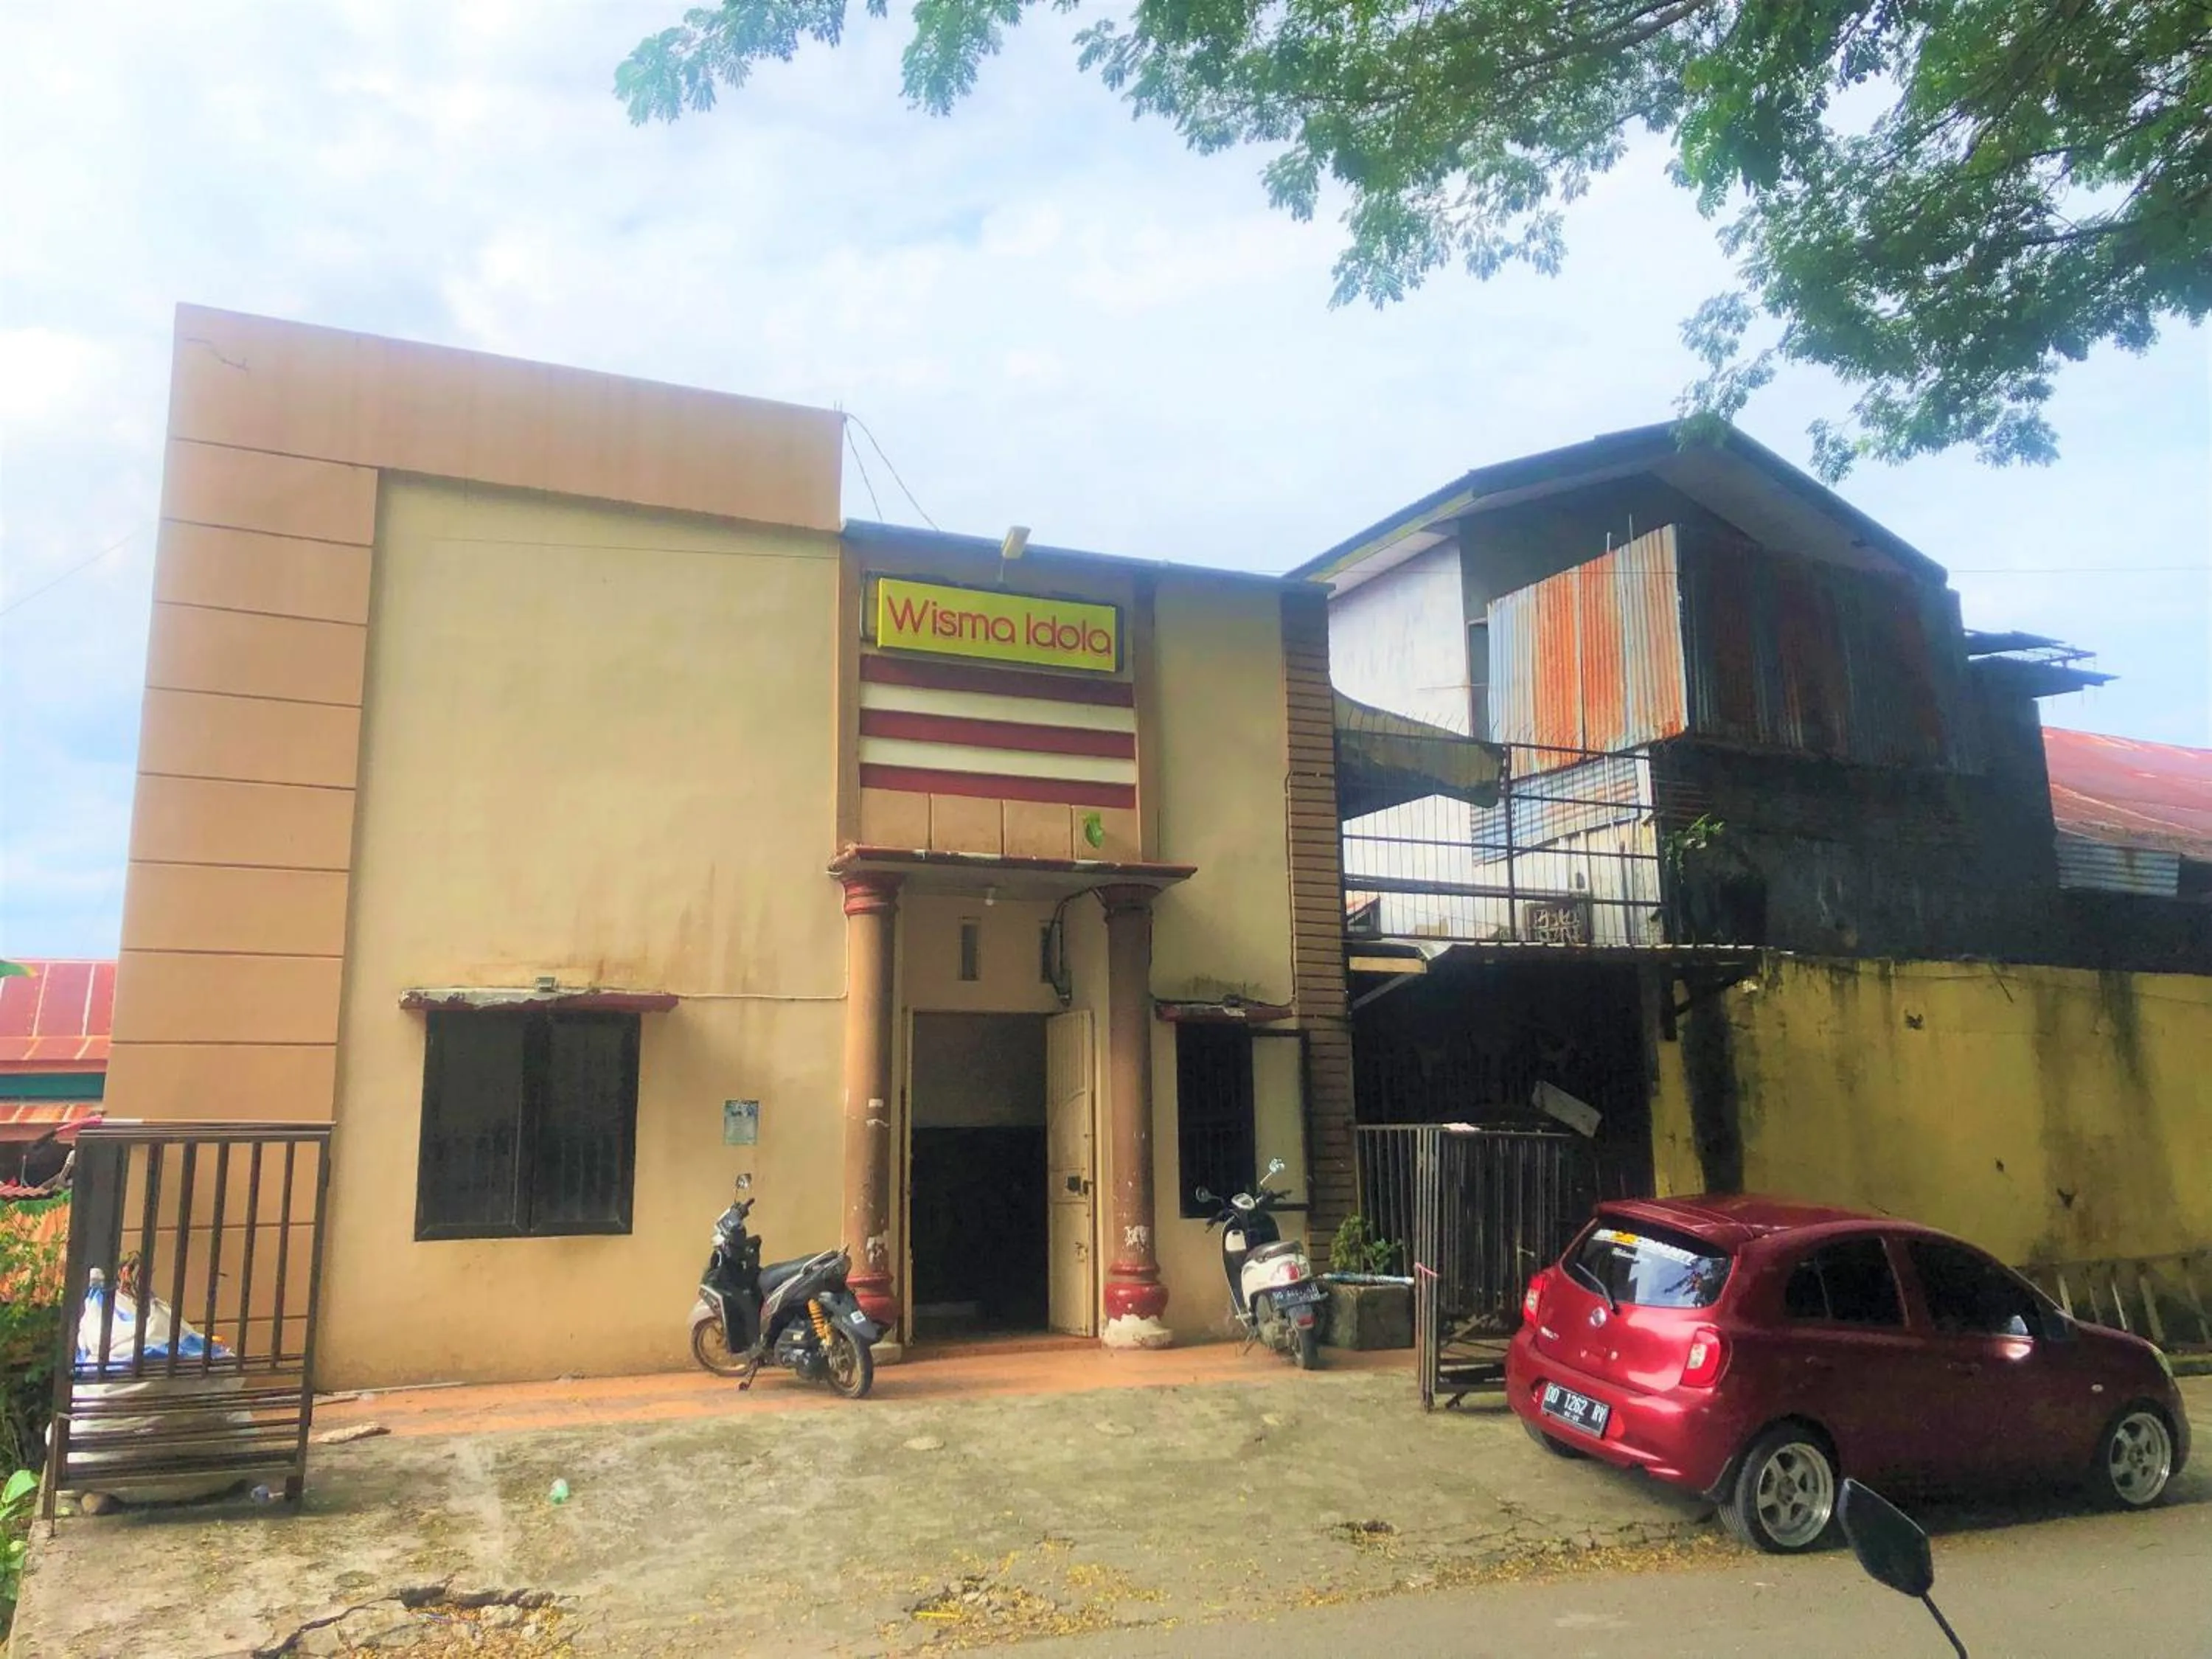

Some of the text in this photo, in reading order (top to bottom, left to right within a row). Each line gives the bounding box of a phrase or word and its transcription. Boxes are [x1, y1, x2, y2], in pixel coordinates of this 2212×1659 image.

[886, 595, 1112, 655] Wisma Idola
[1564, 1394, 1587, 1416] 1262
